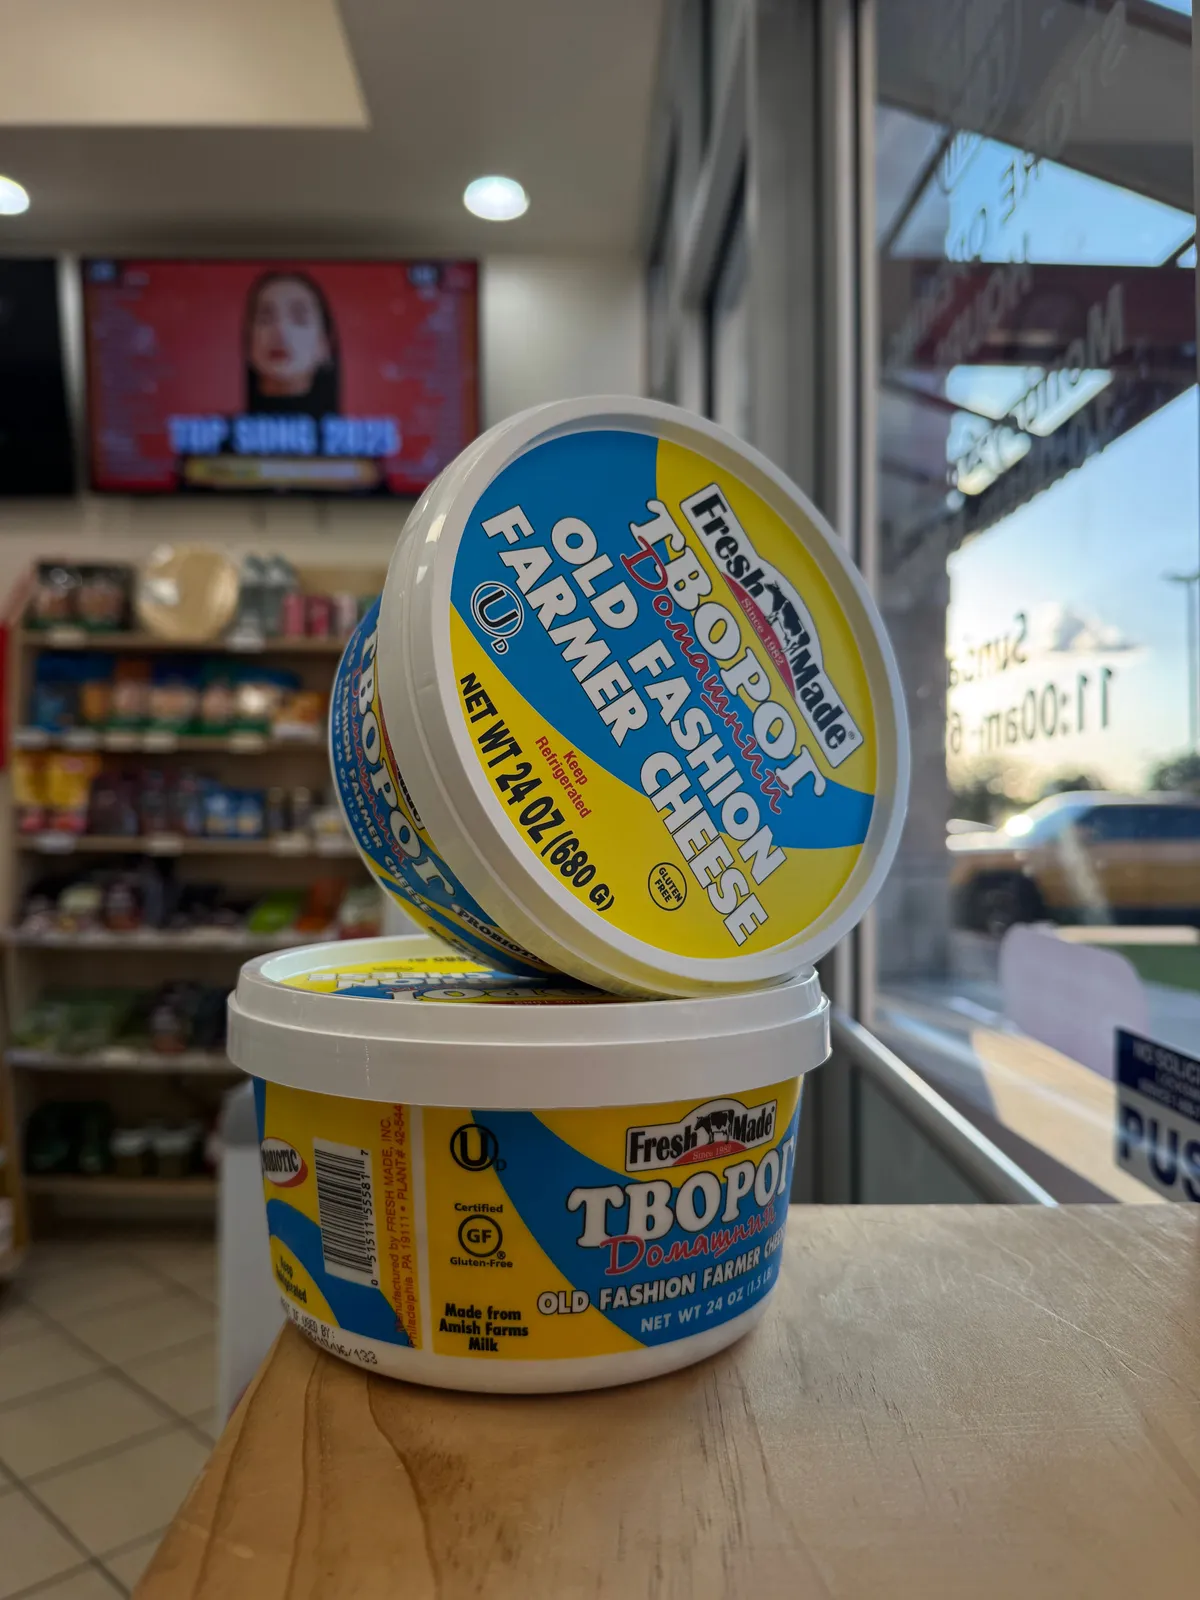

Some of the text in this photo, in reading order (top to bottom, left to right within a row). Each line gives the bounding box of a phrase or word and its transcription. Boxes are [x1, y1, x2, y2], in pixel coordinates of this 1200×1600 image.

[169, 415, 228, 453] TOP
[234, 416, 317, 455] SONG
[691, 493, 847, 752] Fresh Made
[740, 598, 785, 667] Since 1982
[629, 499, 827, 798] ТВОРОГ
[550, 516, 788, 887] OLD FASHION
[480, 504, 769, 947] FARMER CHEESE
[535, 735, 593, 819] Refrigerated
[563, 749, 588, 787] Keep
[460, 672, 616, 912] NET WT 24 OZ (680 G)
[349, 767, 384, 849] FARMER
[384, 855, 431, 914] CHEESE
[654, 878, 672, 904] FREE
[658, 866, 684, 904] GLUTEN
[1154, 1048, 1200, 1085] SOLICI
[630, 1107, 774, 1164] Fresh Made
[692, 1150, 714, 1161] Since
[1119, 1104, 1200, 1203] PUS
[360, 1174, 373, 1216] 55581
[385, 1189, 397, 1232] FRESH
[454, 1202, 504, 1213] Certified
[566, 1134, 796, 1249] ТВОРОГ
[364, 1222, 377, 1263] 51511
[389, 1236, 401, 1251] by
[399, 1216, 411, 1250] 19111
[466, 1228, 493, 1244] GF
[449, 1256, 514, 1269] Gluten-Free
[537, 1289, 590, 1316] OLD
[599, 1271, 696, 1311] FASHION
[701, 1244, 761, 1290] FARMER
[439, 1318, 529, 1337] Amish Farms
[444, 1303, 522, 1321] Made from
[640, 1312, 672, 1333] NET
[677, 1304, 702, 1324] WT
[705, 1295, 723, 1316] 24
[727, 1286, 745, 1306] OZ
[468, 1337, 499, 1353] Milk
